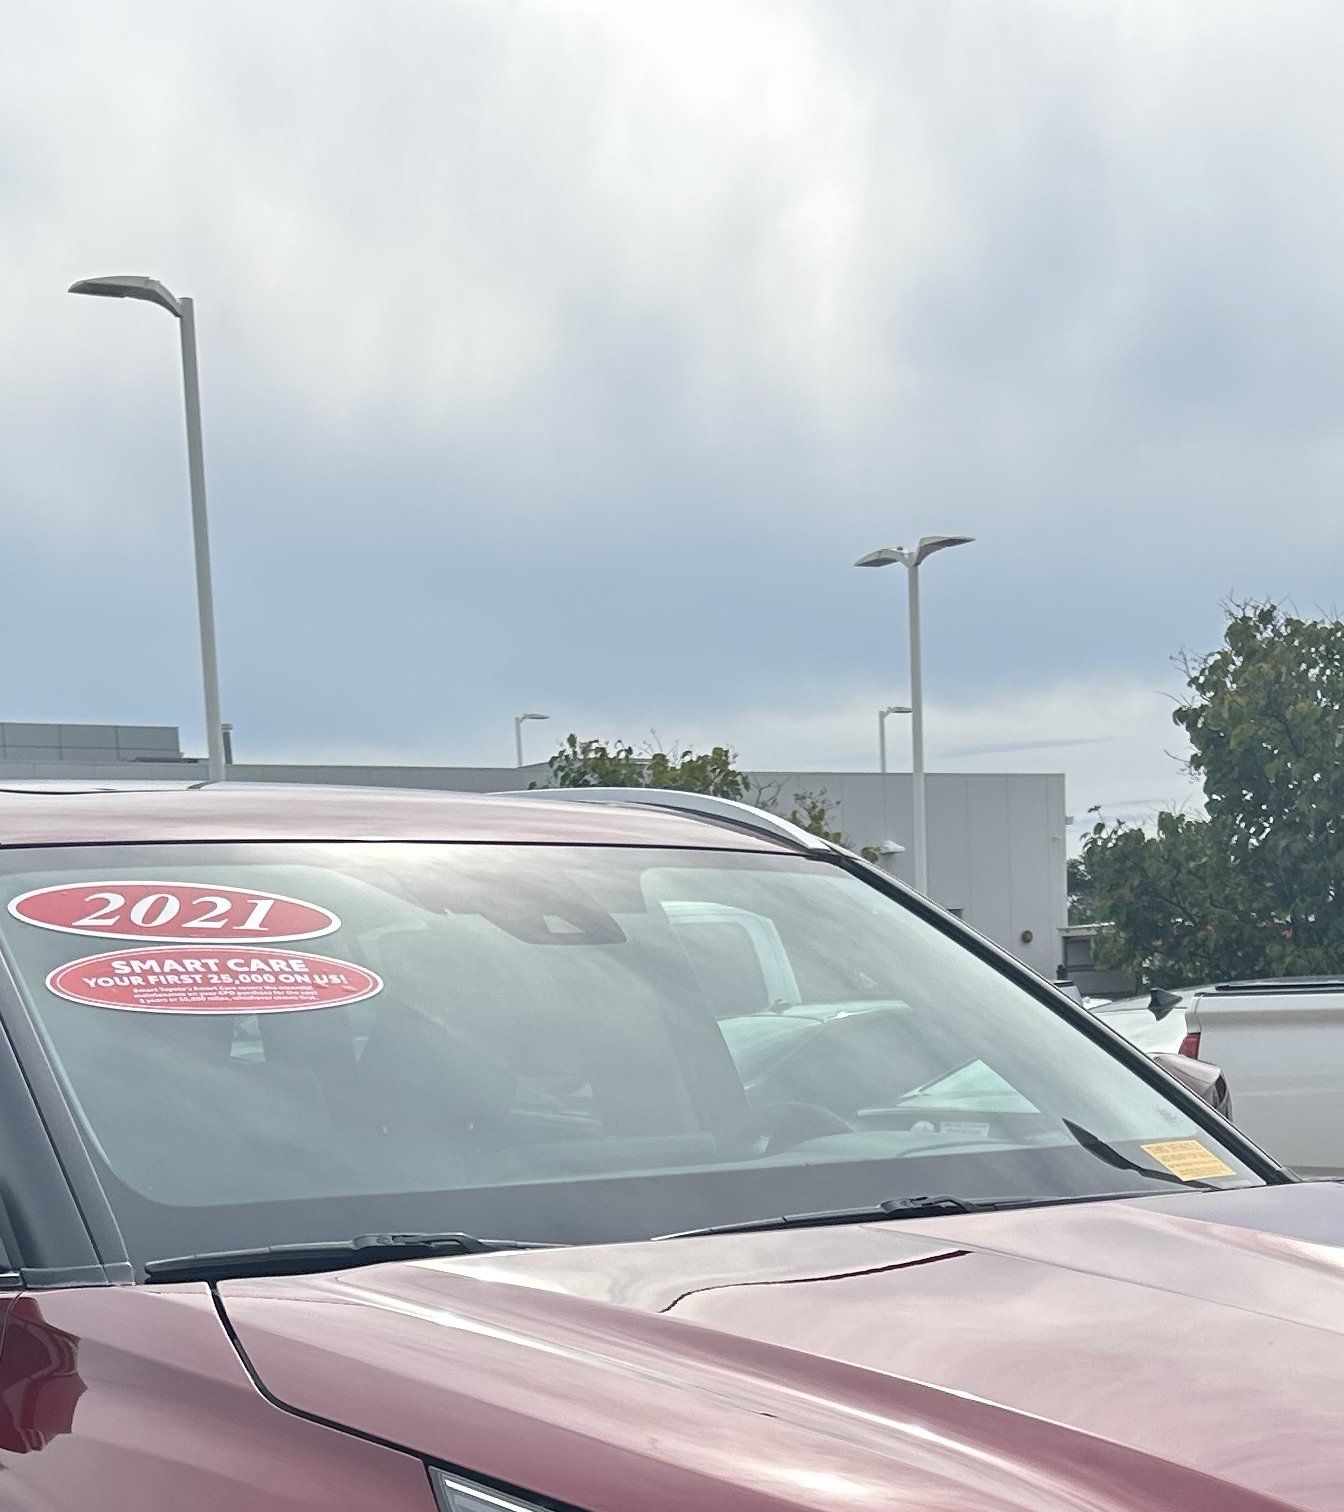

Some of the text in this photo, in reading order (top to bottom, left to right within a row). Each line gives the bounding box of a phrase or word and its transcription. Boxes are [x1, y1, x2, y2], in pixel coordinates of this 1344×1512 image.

[72, 892, 275, 932] 2021
[112, 958, 309, 975] SMART CARE
[82, 975, 152, 988] YOUR
[152, 975, 204, 986] FIRST
[207, 974, 276, 986] 25,000
[278, 974, 311, 985] ON
